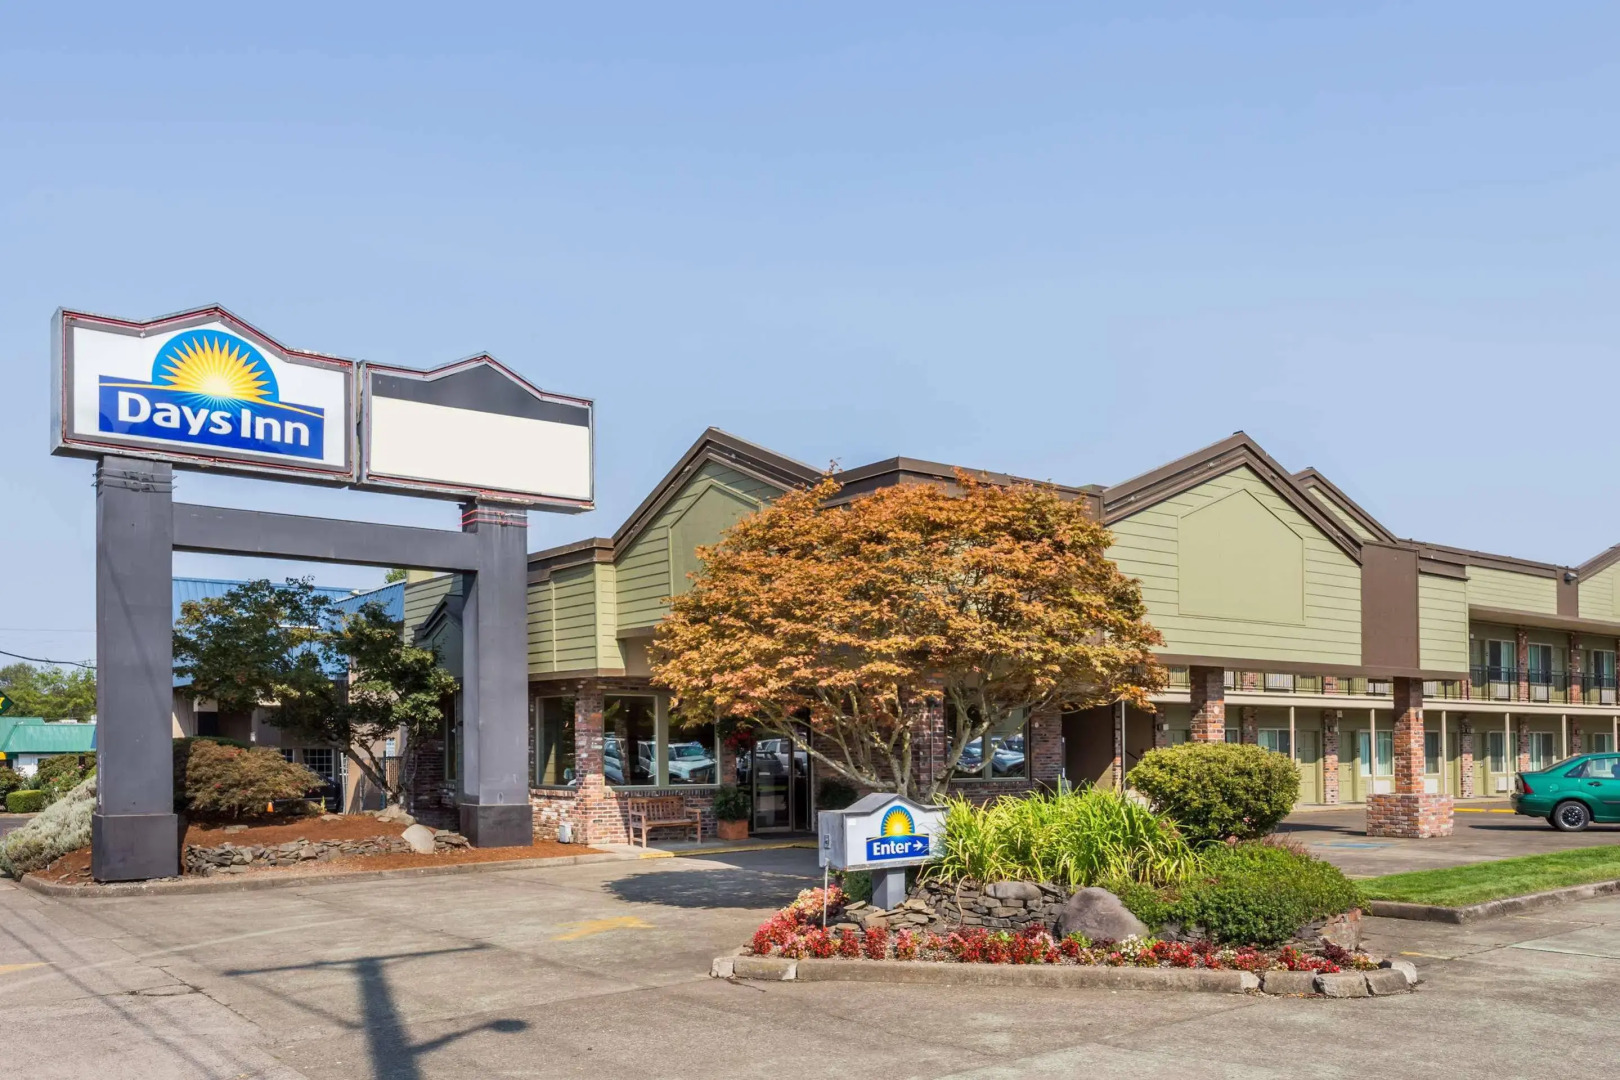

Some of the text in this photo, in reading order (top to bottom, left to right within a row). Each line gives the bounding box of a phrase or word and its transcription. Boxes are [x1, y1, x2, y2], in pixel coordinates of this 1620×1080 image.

[118, 391, 310, 447] Days Inn
[873, 841, 911, 856] Enter
